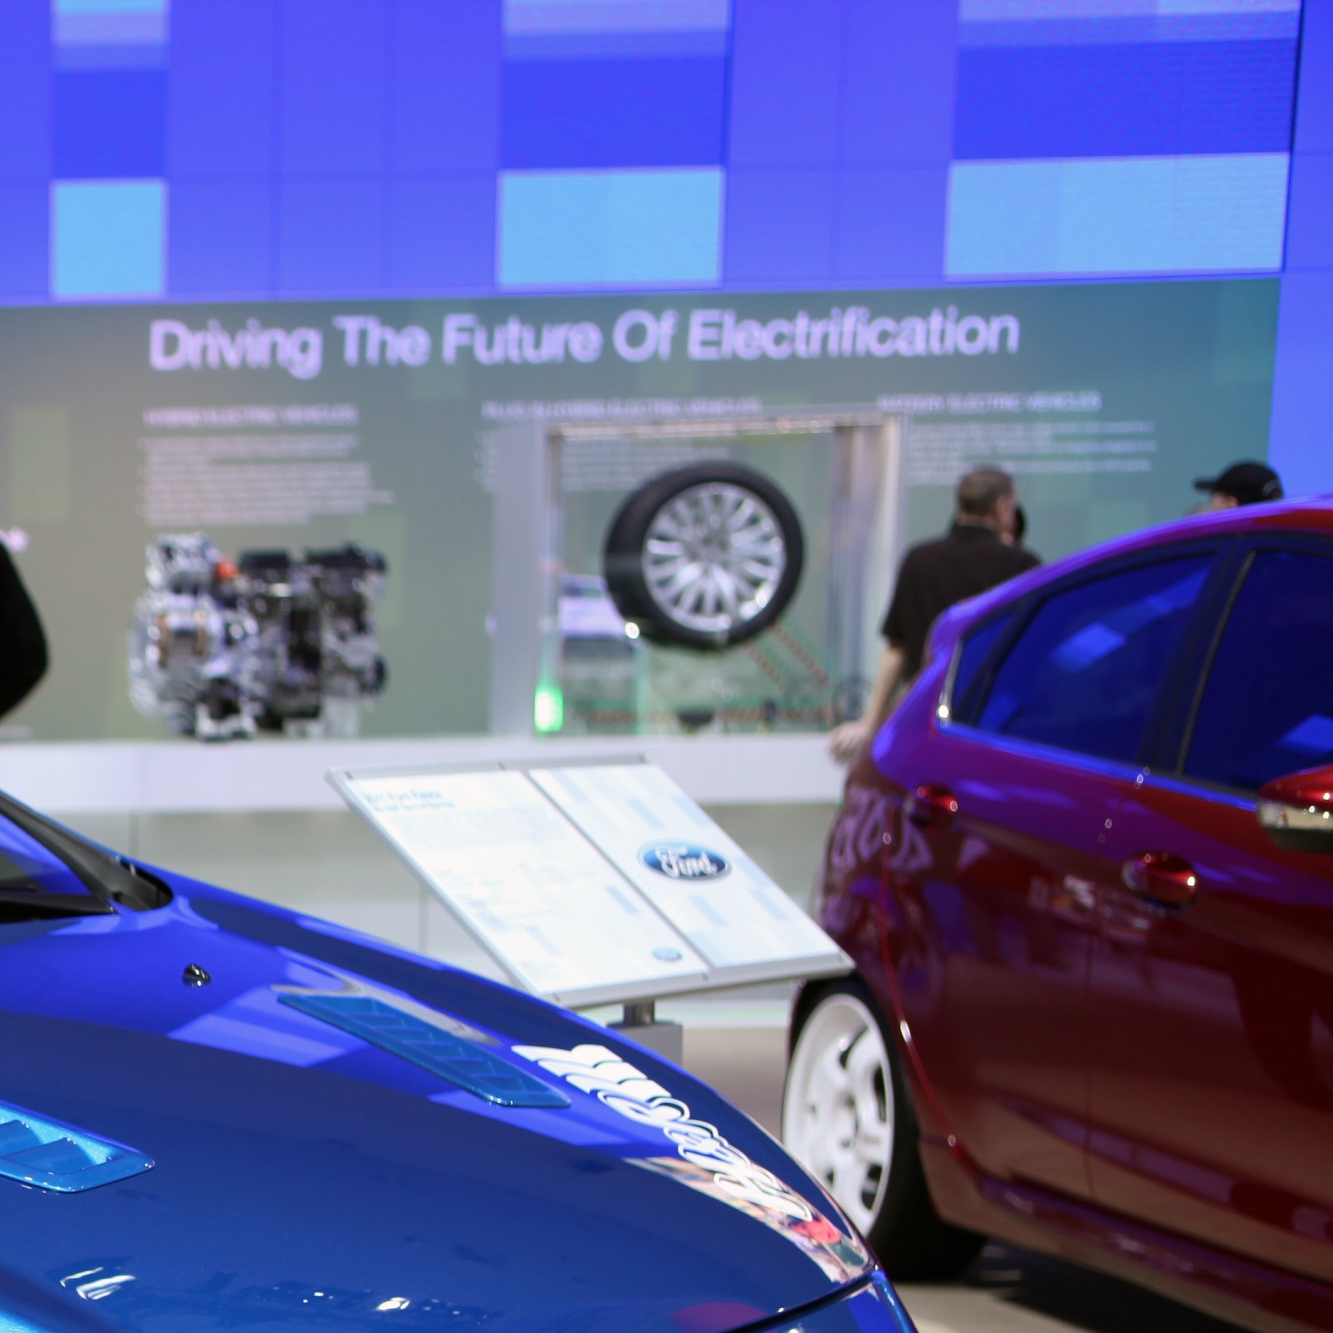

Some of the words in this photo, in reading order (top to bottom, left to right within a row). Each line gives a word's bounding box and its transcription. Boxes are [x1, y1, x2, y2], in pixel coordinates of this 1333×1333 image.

[149, 317, 323, 380] Driving
[332, 313, 432, 367] The
[441, 312, 603, 366] Future
[612, 307, 680, 363] Of
[687, 304, 1020, 361] Electrification
[654, 845, 719, 878] Ford
